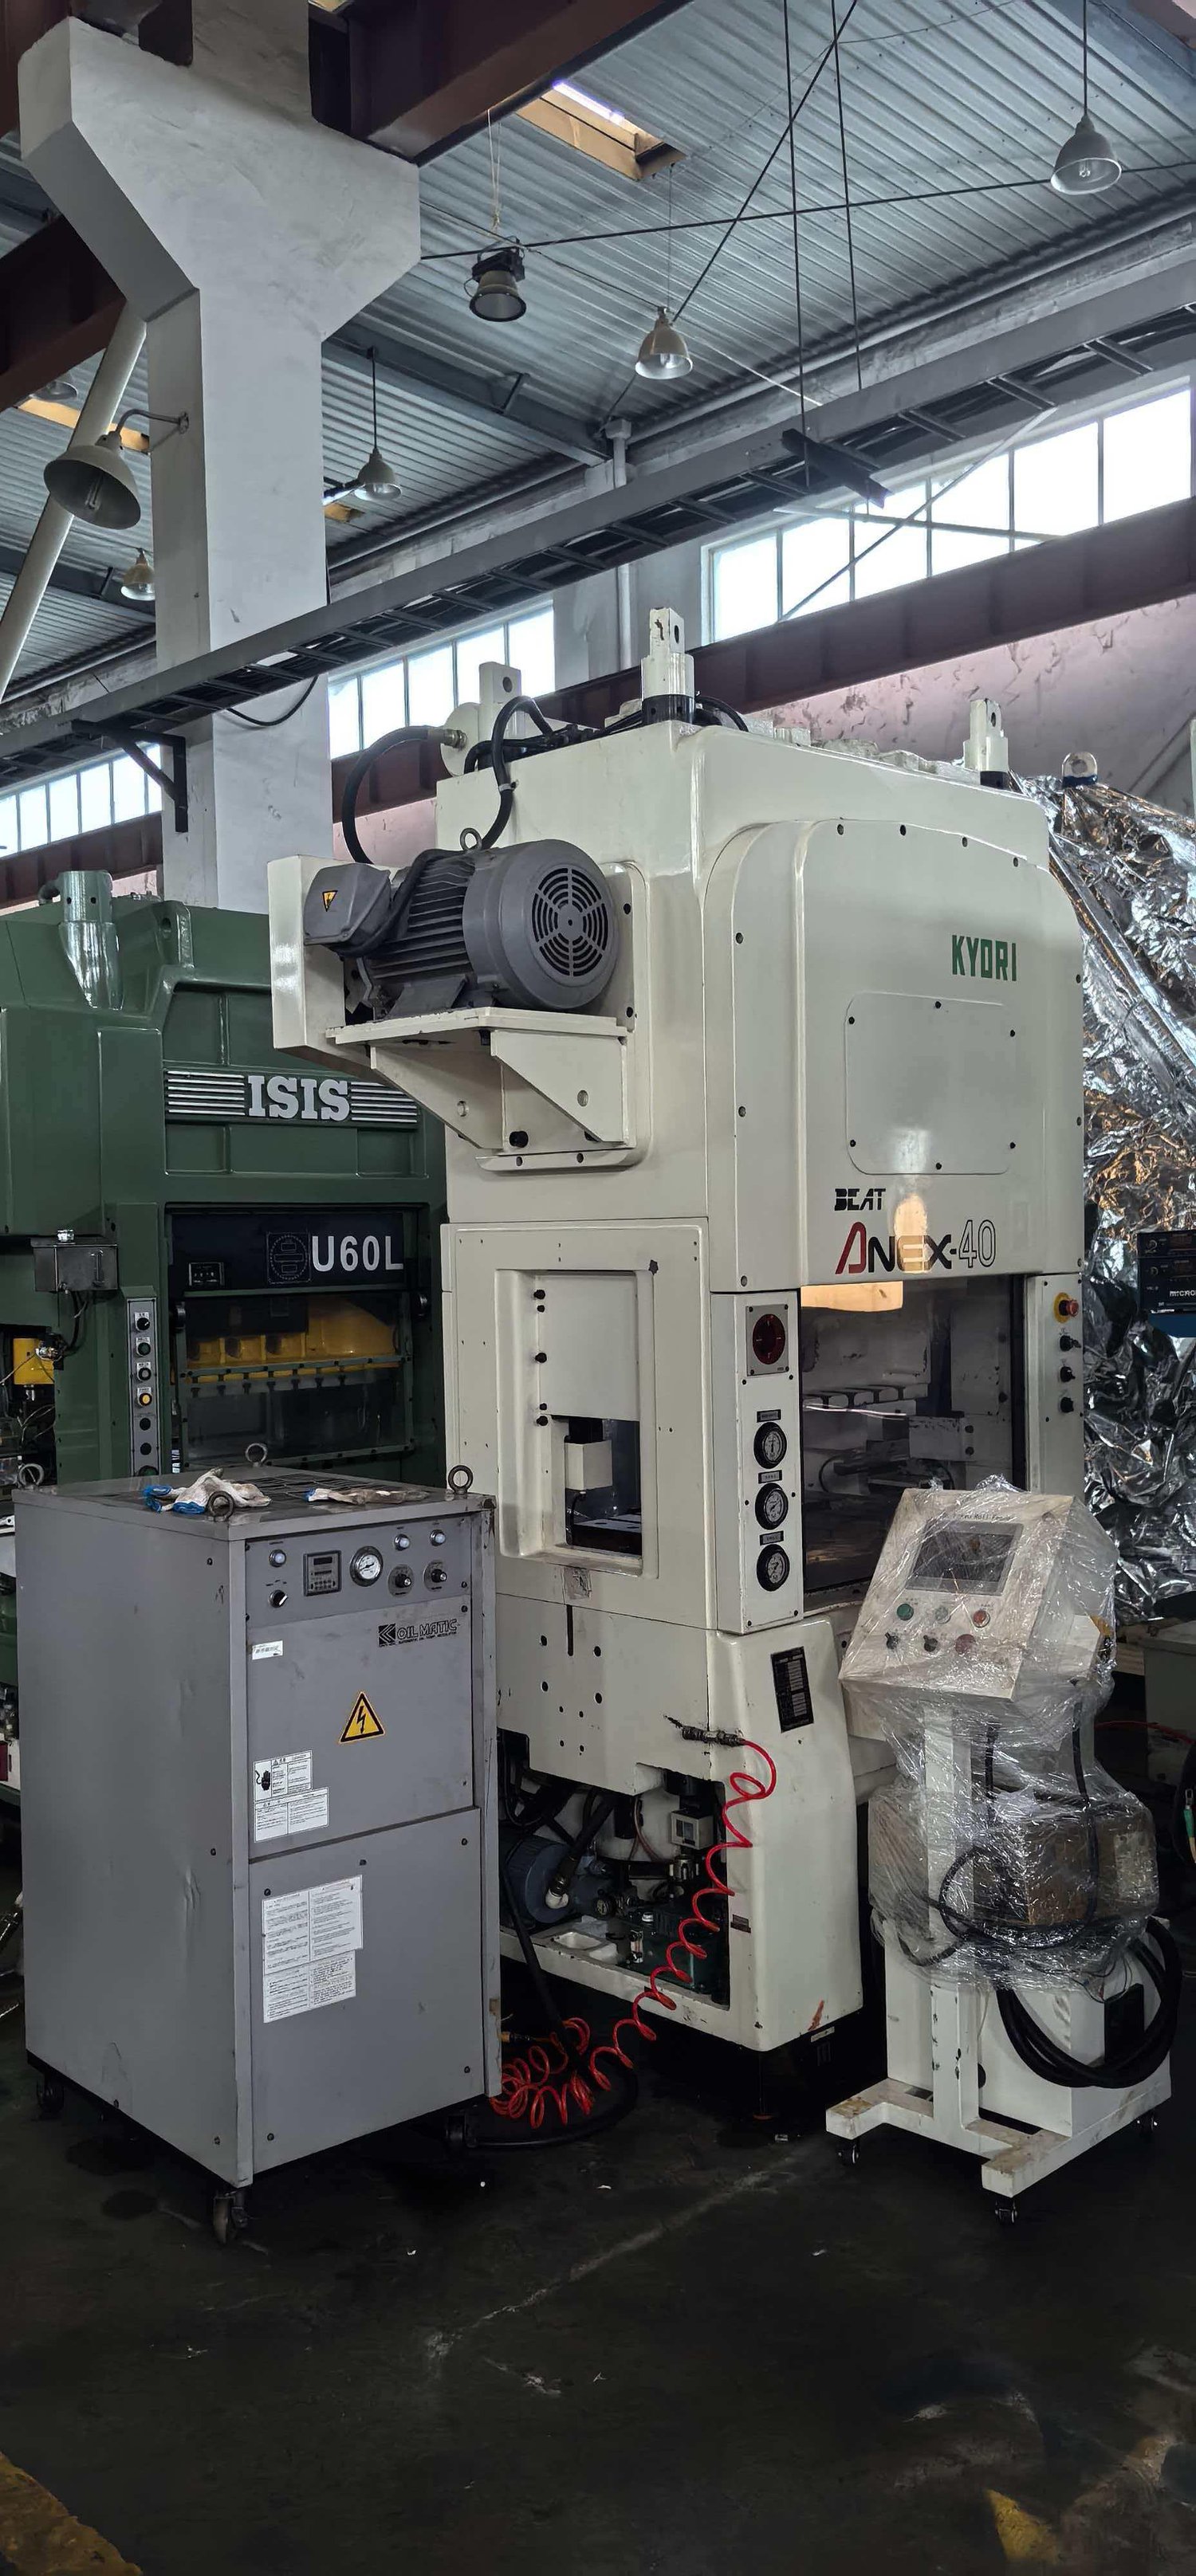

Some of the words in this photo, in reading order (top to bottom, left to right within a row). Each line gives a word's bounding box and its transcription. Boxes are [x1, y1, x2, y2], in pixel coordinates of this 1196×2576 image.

[952, 934, 1017, 981] KYORI
[248, 1075, 350, 1121] ISIS
[835, 1188, 886, 1211] BEAT
[312, 1235, 403, 1272] U60L
[397, 1626, 418, 1639] OIL
[419, 1619, 457, 1636] MATIC
